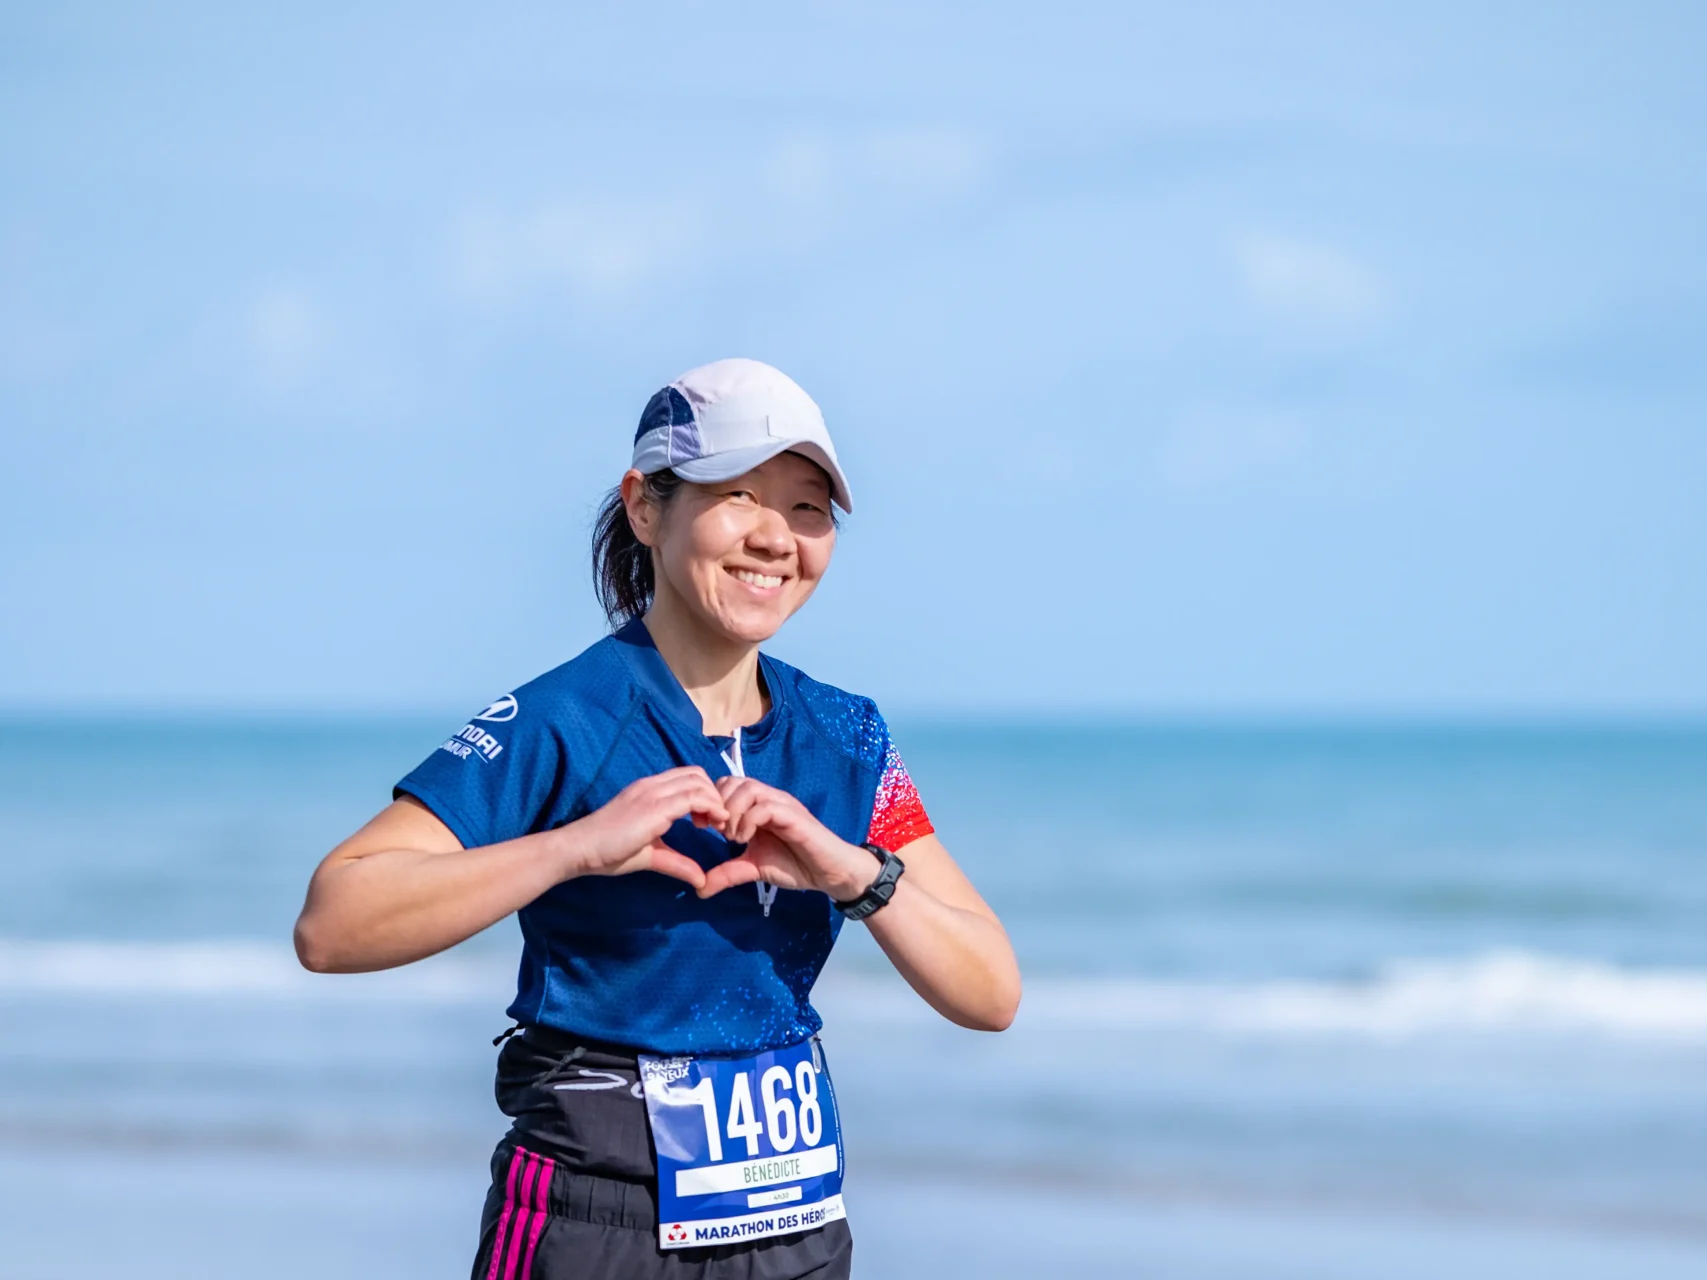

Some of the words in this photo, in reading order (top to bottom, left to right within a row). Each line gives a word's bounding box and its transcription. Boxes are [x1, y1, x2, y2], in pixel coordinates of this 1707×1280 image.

[443, 739, 473, 760] MUR
[456, 723, 503, 760] NDAI
[699, 1060, 822, 1162] 1468
[743, 1158, 801, 1184] BÉNÉDICTE
[695, 1218, 774, 1241] MARATHON
[778, 1214, 798, 1230] DES
